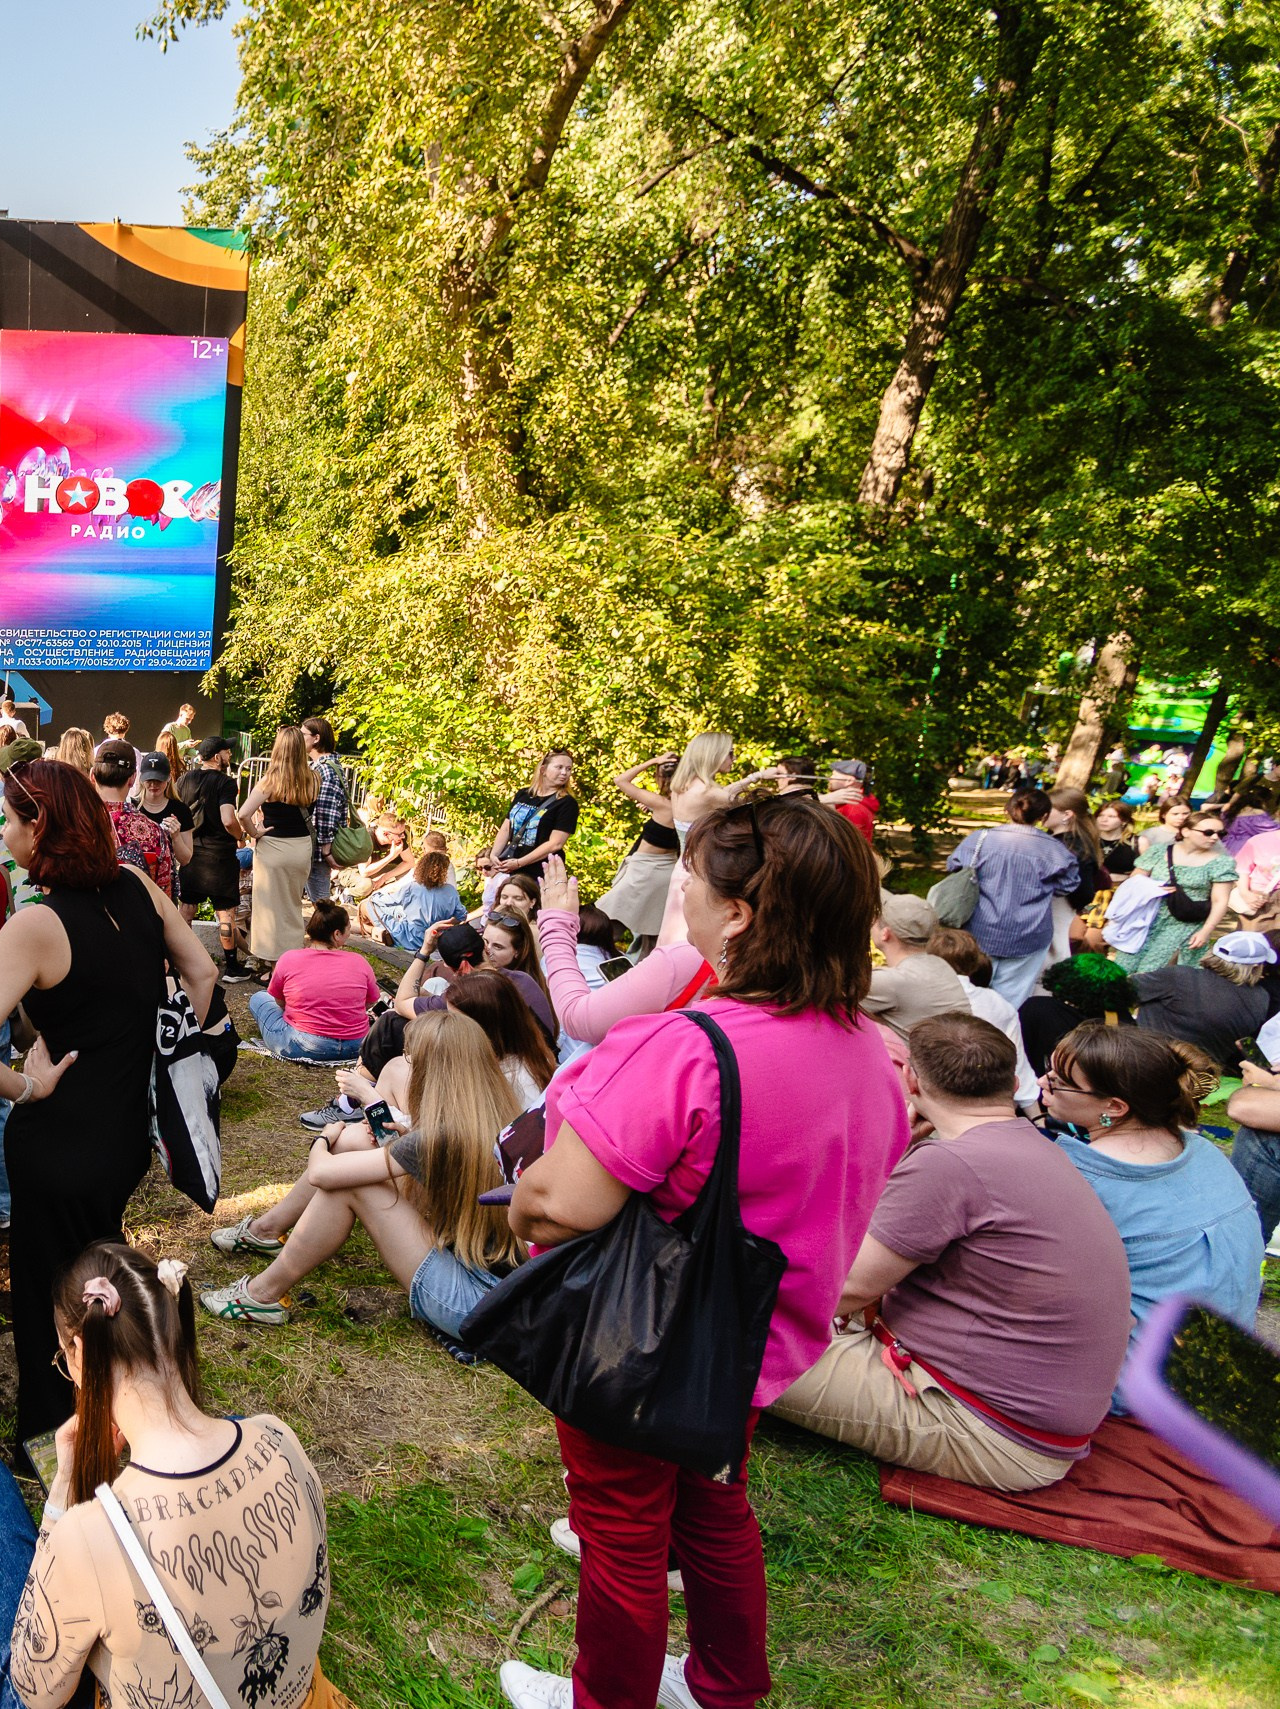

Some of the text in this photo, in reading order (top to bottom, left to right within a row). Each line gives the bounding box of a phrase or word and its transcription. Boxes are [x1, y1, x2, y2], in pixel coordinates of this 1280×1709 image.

[190, 340, 224, 359] 12+
[71, 524, 145, 540] РАДИО
[0, 629, 87, 638] СВИДЕТЕЛЬСТВО
[99, 630, 171, 639] РЕГИСТРАЦИИ
[173, 630, 196, 638] СМИ
[15, 639, 74, 647] ФС77-63569
[96, 639, 142, 647] 30.10.2015
[156, 640, 210, 648] ЛИЦЕНЗИЯ
[0, 648, 210, 658] НА ОСУЩЕСТВЛЕНИЕ РАДИОВЕЩАНИЯ
[3, 658, 15, 666] №
[17, 658, 130, 666] Л033-00114-77/00152707
[148, 658, 197, 666] 29.04.2022
